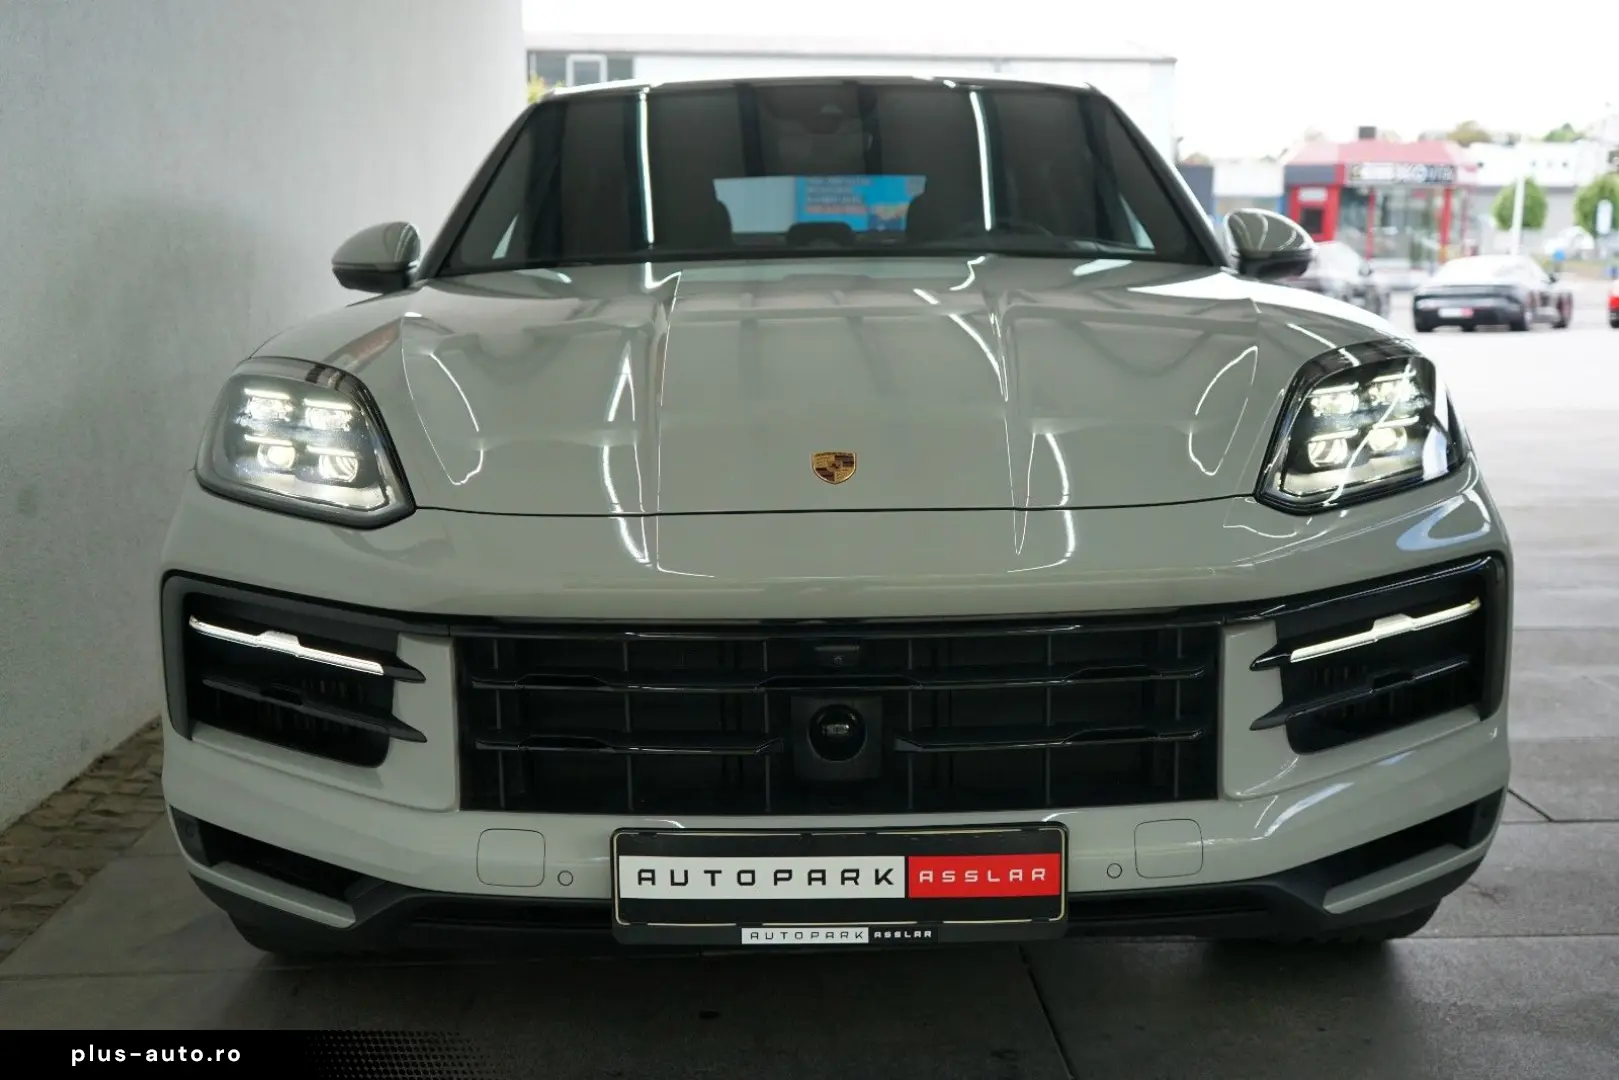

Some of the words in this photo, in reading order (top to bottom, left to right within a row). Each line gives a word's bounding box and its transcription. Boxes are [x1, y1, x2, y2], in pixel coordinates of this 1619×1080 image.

[636, 867, 895, 887] AUTOPARK
[918, 867, 1048, 883] ASSLAR
[749, 930, 865, 942] AUTOPARK
[873, 929, 933, 939] ASSLAR
